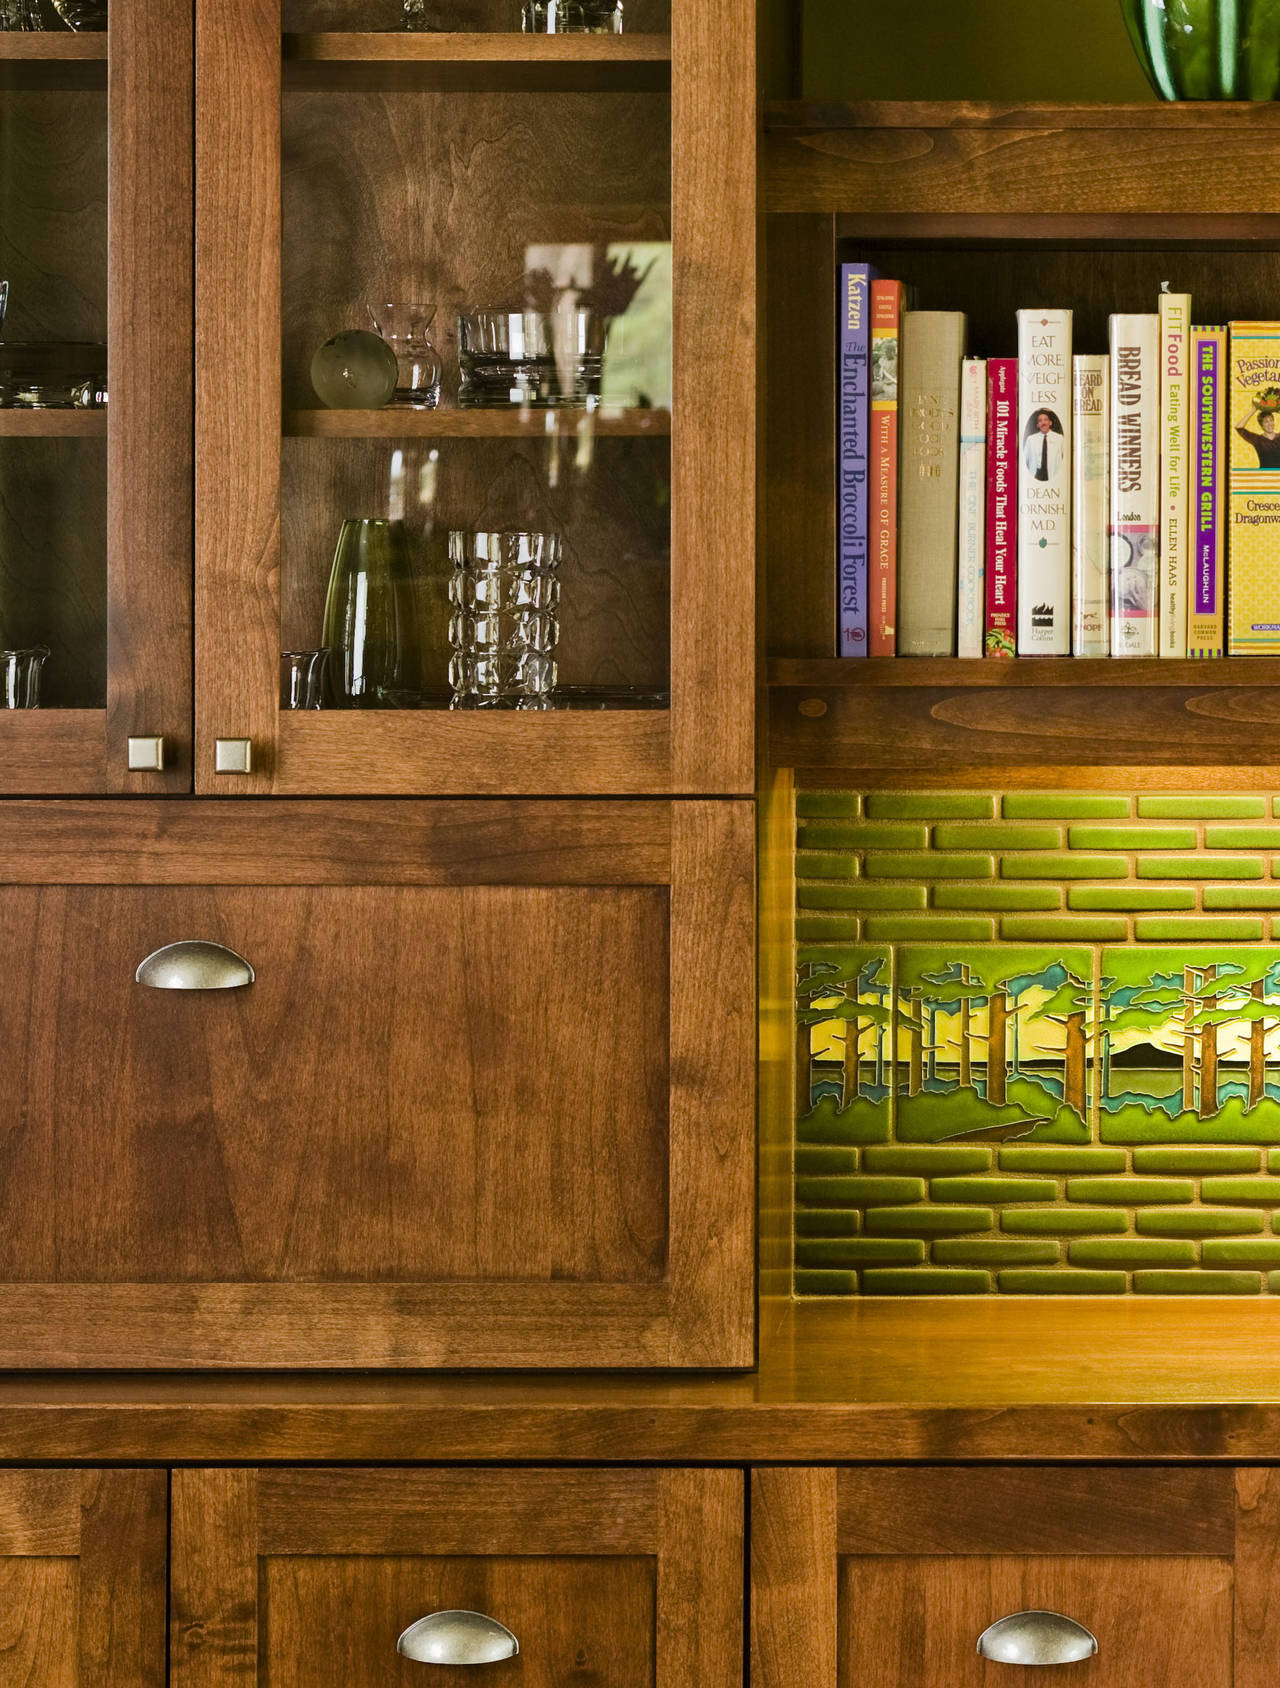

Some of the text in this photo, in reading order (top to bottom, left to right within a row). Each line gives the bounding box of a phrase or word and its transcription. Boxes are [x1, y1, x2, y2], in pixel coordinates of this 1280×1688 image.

[847, 273, 867, 330] Katzen
[1031, 335, 1056, 348] EAT
[1031, 390, 1057, 403] LESS
[1081, 386, 1095, 399] ON
[880, 415, 891, 444] WITH
[1117, 346, 1142, 493] BREAD WINNERS
[1167, 384, 1182, 498] Eating Well for Life
[1200, 345, 1214, 532] THE SOUTHWESTERN GRILL
[842, 353, 866, 615] Enchanted Broccoli Forest
[879, 456, 891, 506] MEASURE
[994, 400, 1010, 605] 101 Miracle Foods That Heal Your Heart
[1026, 487, 1061, 499] DEAN
[879, 509, 890, 526] OF
[879, 529, 890, 570] GRACE
[1168, 518, 1178, 586] ELLEN HAAS
[1202, 545, 1210, 604] McLAUGHLIN
